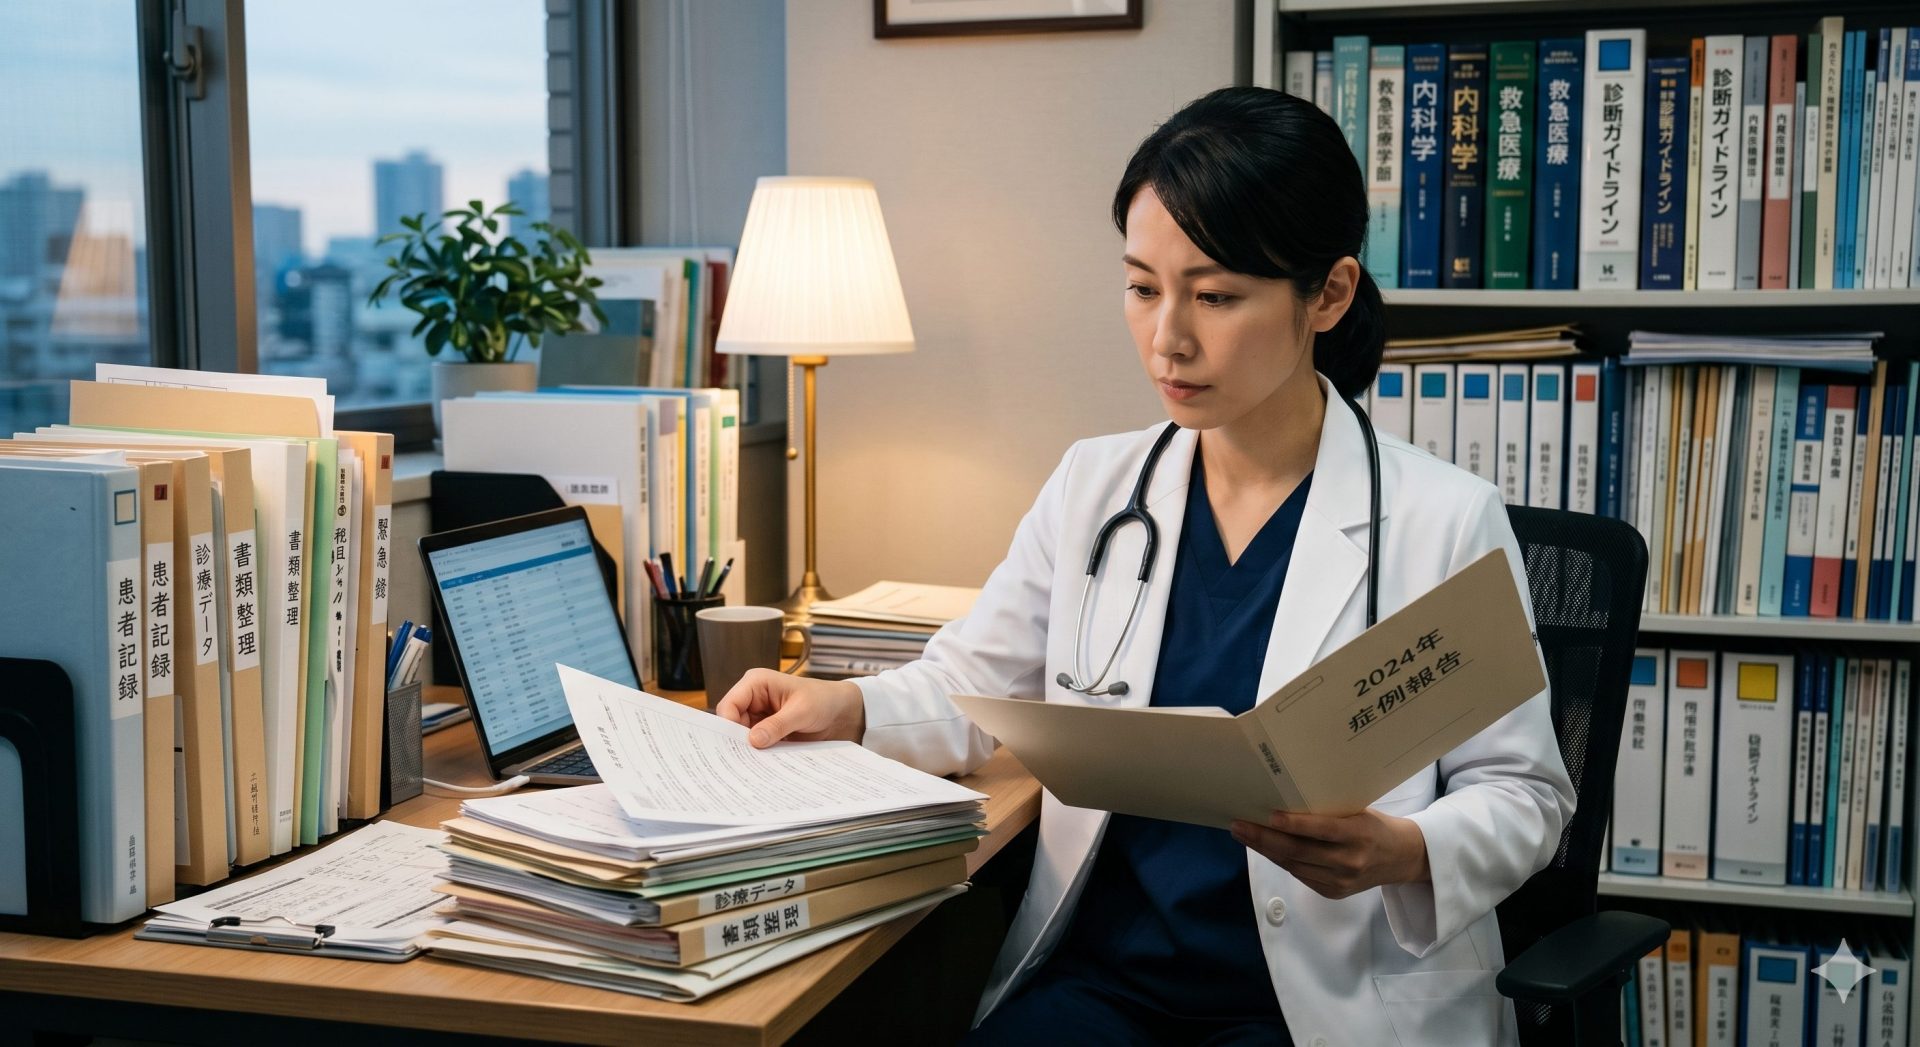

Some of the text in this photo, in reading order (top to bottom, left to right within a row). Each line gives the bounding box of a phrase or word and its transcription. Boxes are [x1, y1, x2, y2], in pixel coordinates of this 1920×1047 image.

[1410, 79, 1438, 162] 内科学
[1451, 85, 1479, 170] 内科学
[1497, 86, 1524, 181] 救急医療
[1546, 79, 1571, 165] 救急医療
[1601, 83, 1624, 235] 診断ガイドライン
[1710, 68, 1733, 219] 診断ガイドライン
[150, 560, 172, 679] 患者記録
[194, 543, 213, 657] 診療データ
[233, 541, 257, 657] 書類整理
[286, 529, 302, 626] 書類整理
[117, 577, 139, 701] 患者記録
[1353, 628, 1444, 697] 2024年
[1348, 650, 1461, 733] 症例報告
[714, 878, 796, 911] 診療データ
[721, 903, 800, 948] 書類整理
